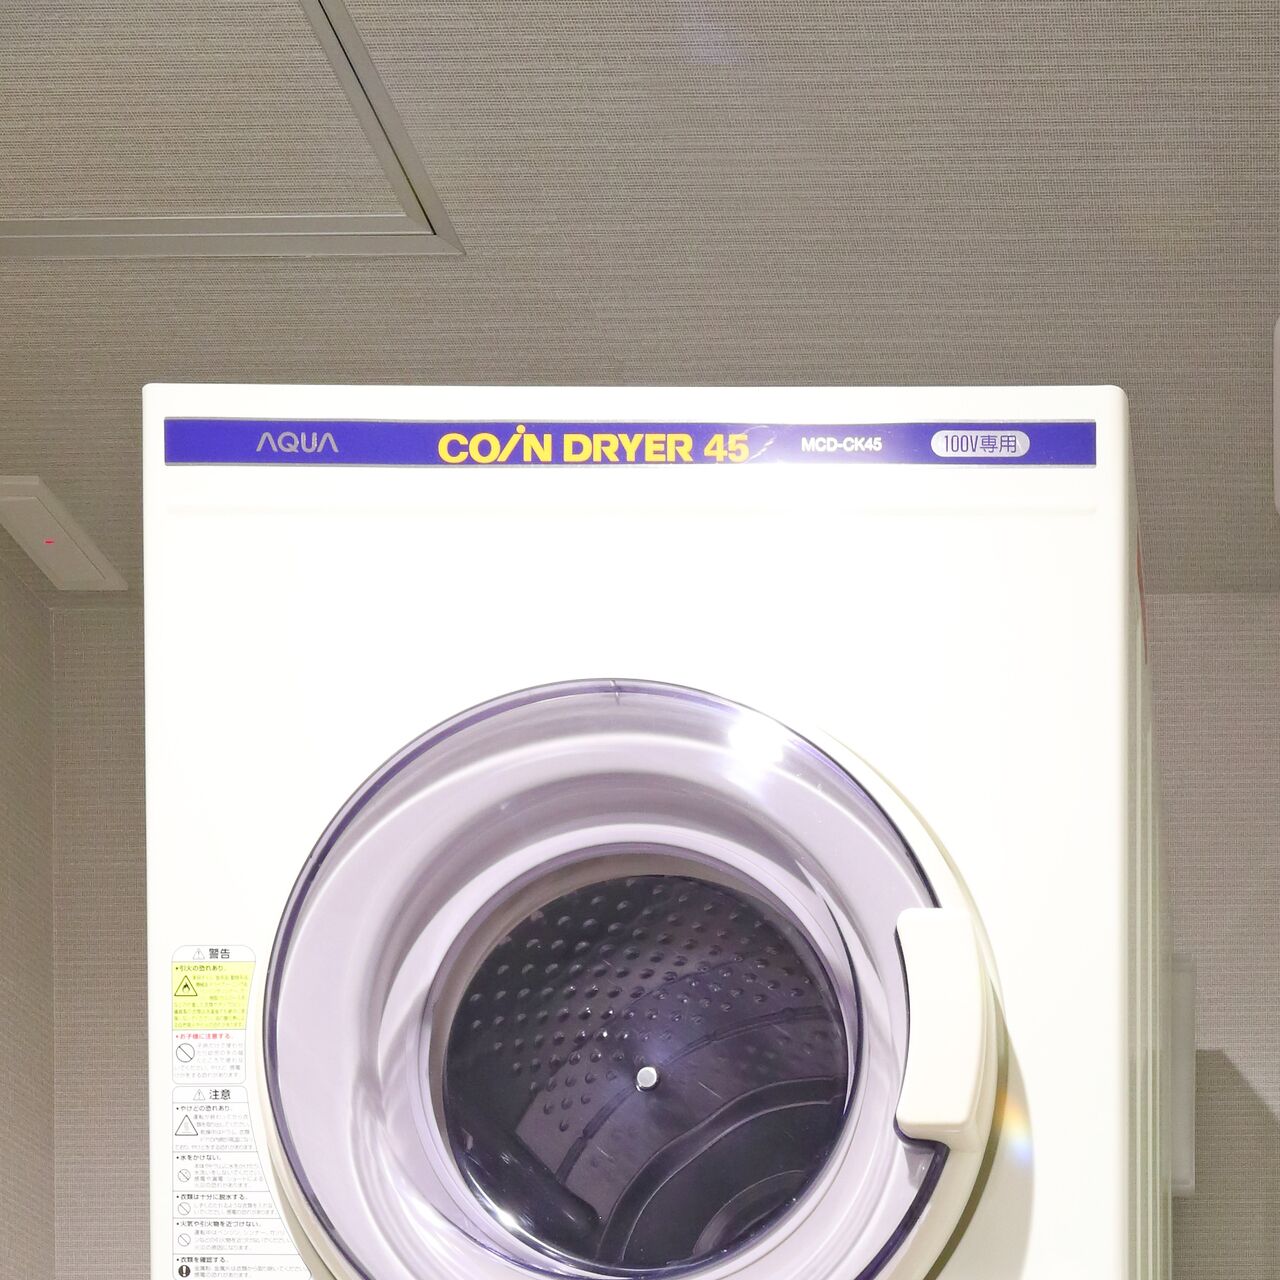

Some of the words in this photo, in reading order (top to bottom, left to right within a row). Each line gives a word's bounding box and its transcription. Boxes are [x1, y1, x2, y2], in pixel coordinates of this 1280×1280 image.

[257, 434, 339, 454] AQUA
[564, 434, 693, 462] DRYER
[704, 434, 749, 462] 45
[802, 436, 882, 454] MCD-CK45
[942, 431, 1018, 454] 100V専用
[209, 948, 230, 959] 警告
[209, 1089, 231, 1100] 注意
